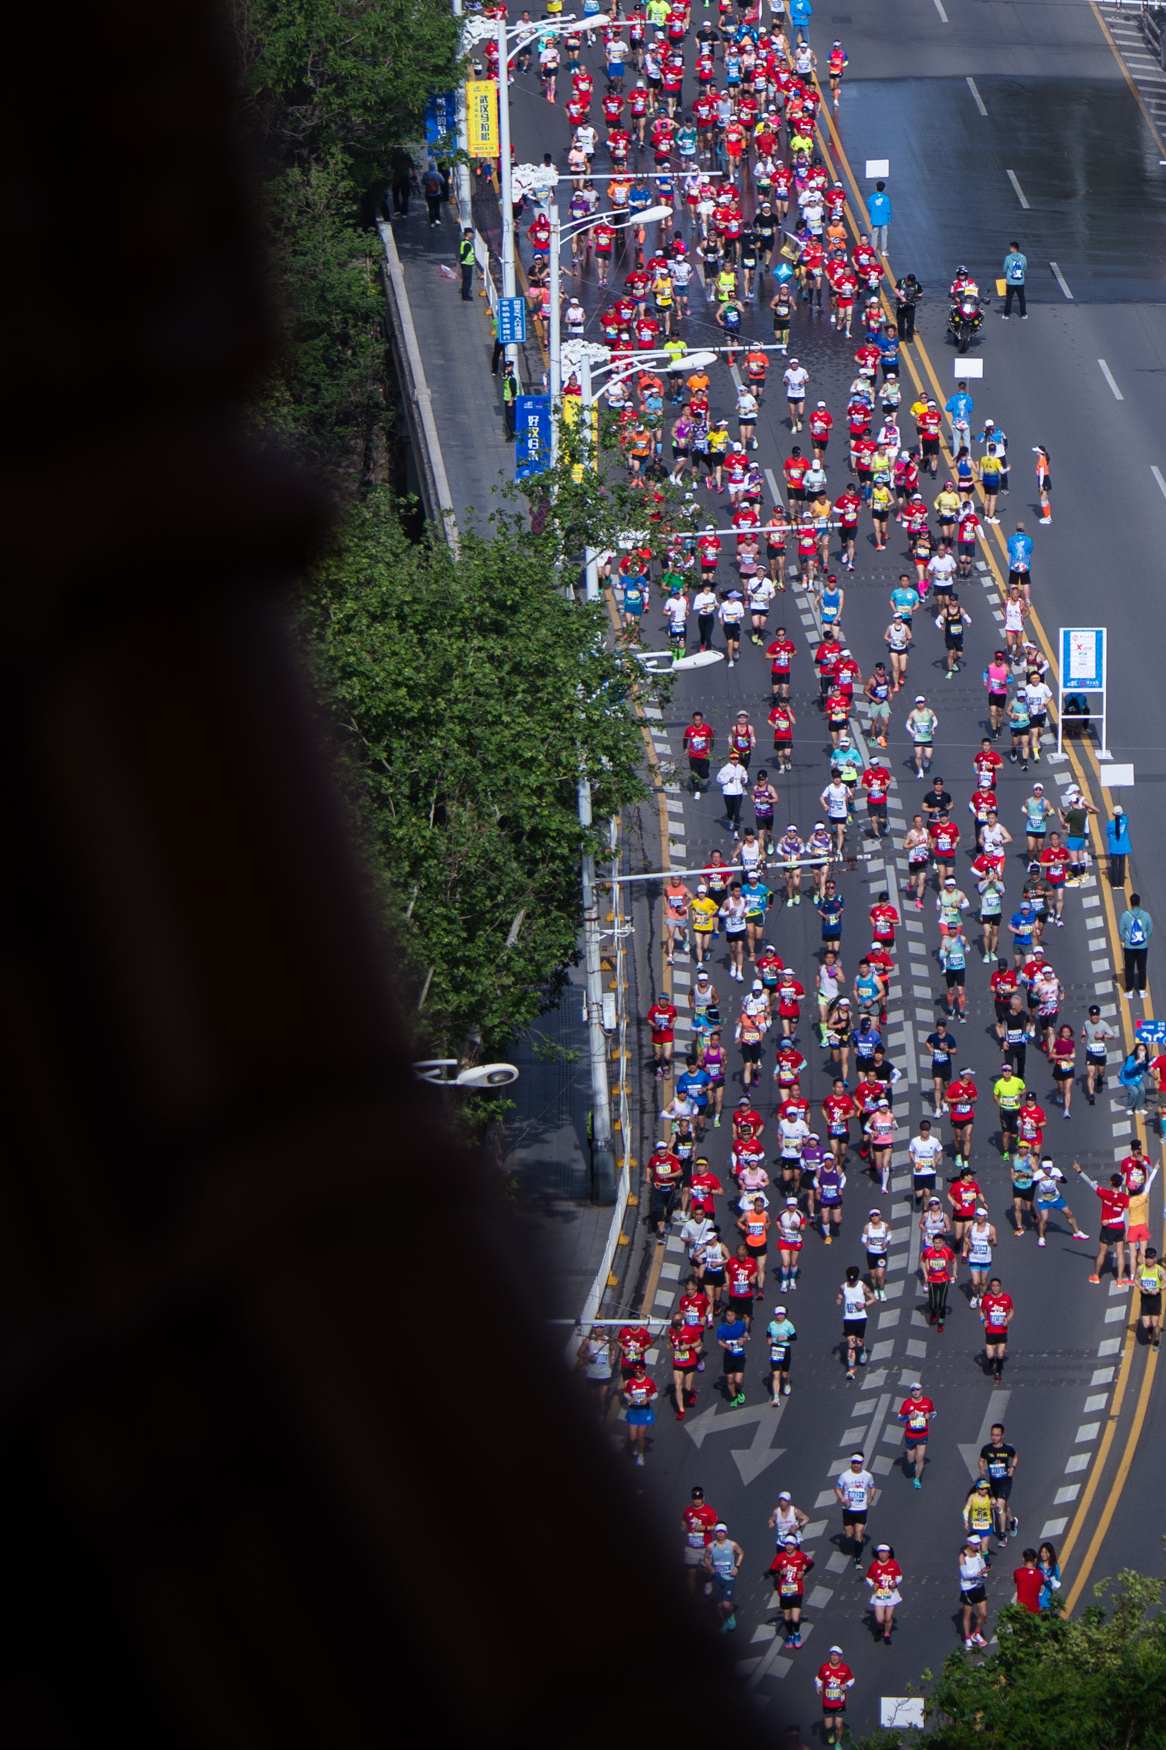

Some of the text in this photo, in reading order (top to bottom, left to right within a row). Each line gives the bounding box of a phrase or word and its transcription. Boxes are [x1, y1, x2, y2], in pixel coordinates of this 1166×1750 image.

[480, 95, 490, 141] 武汉马拉松
